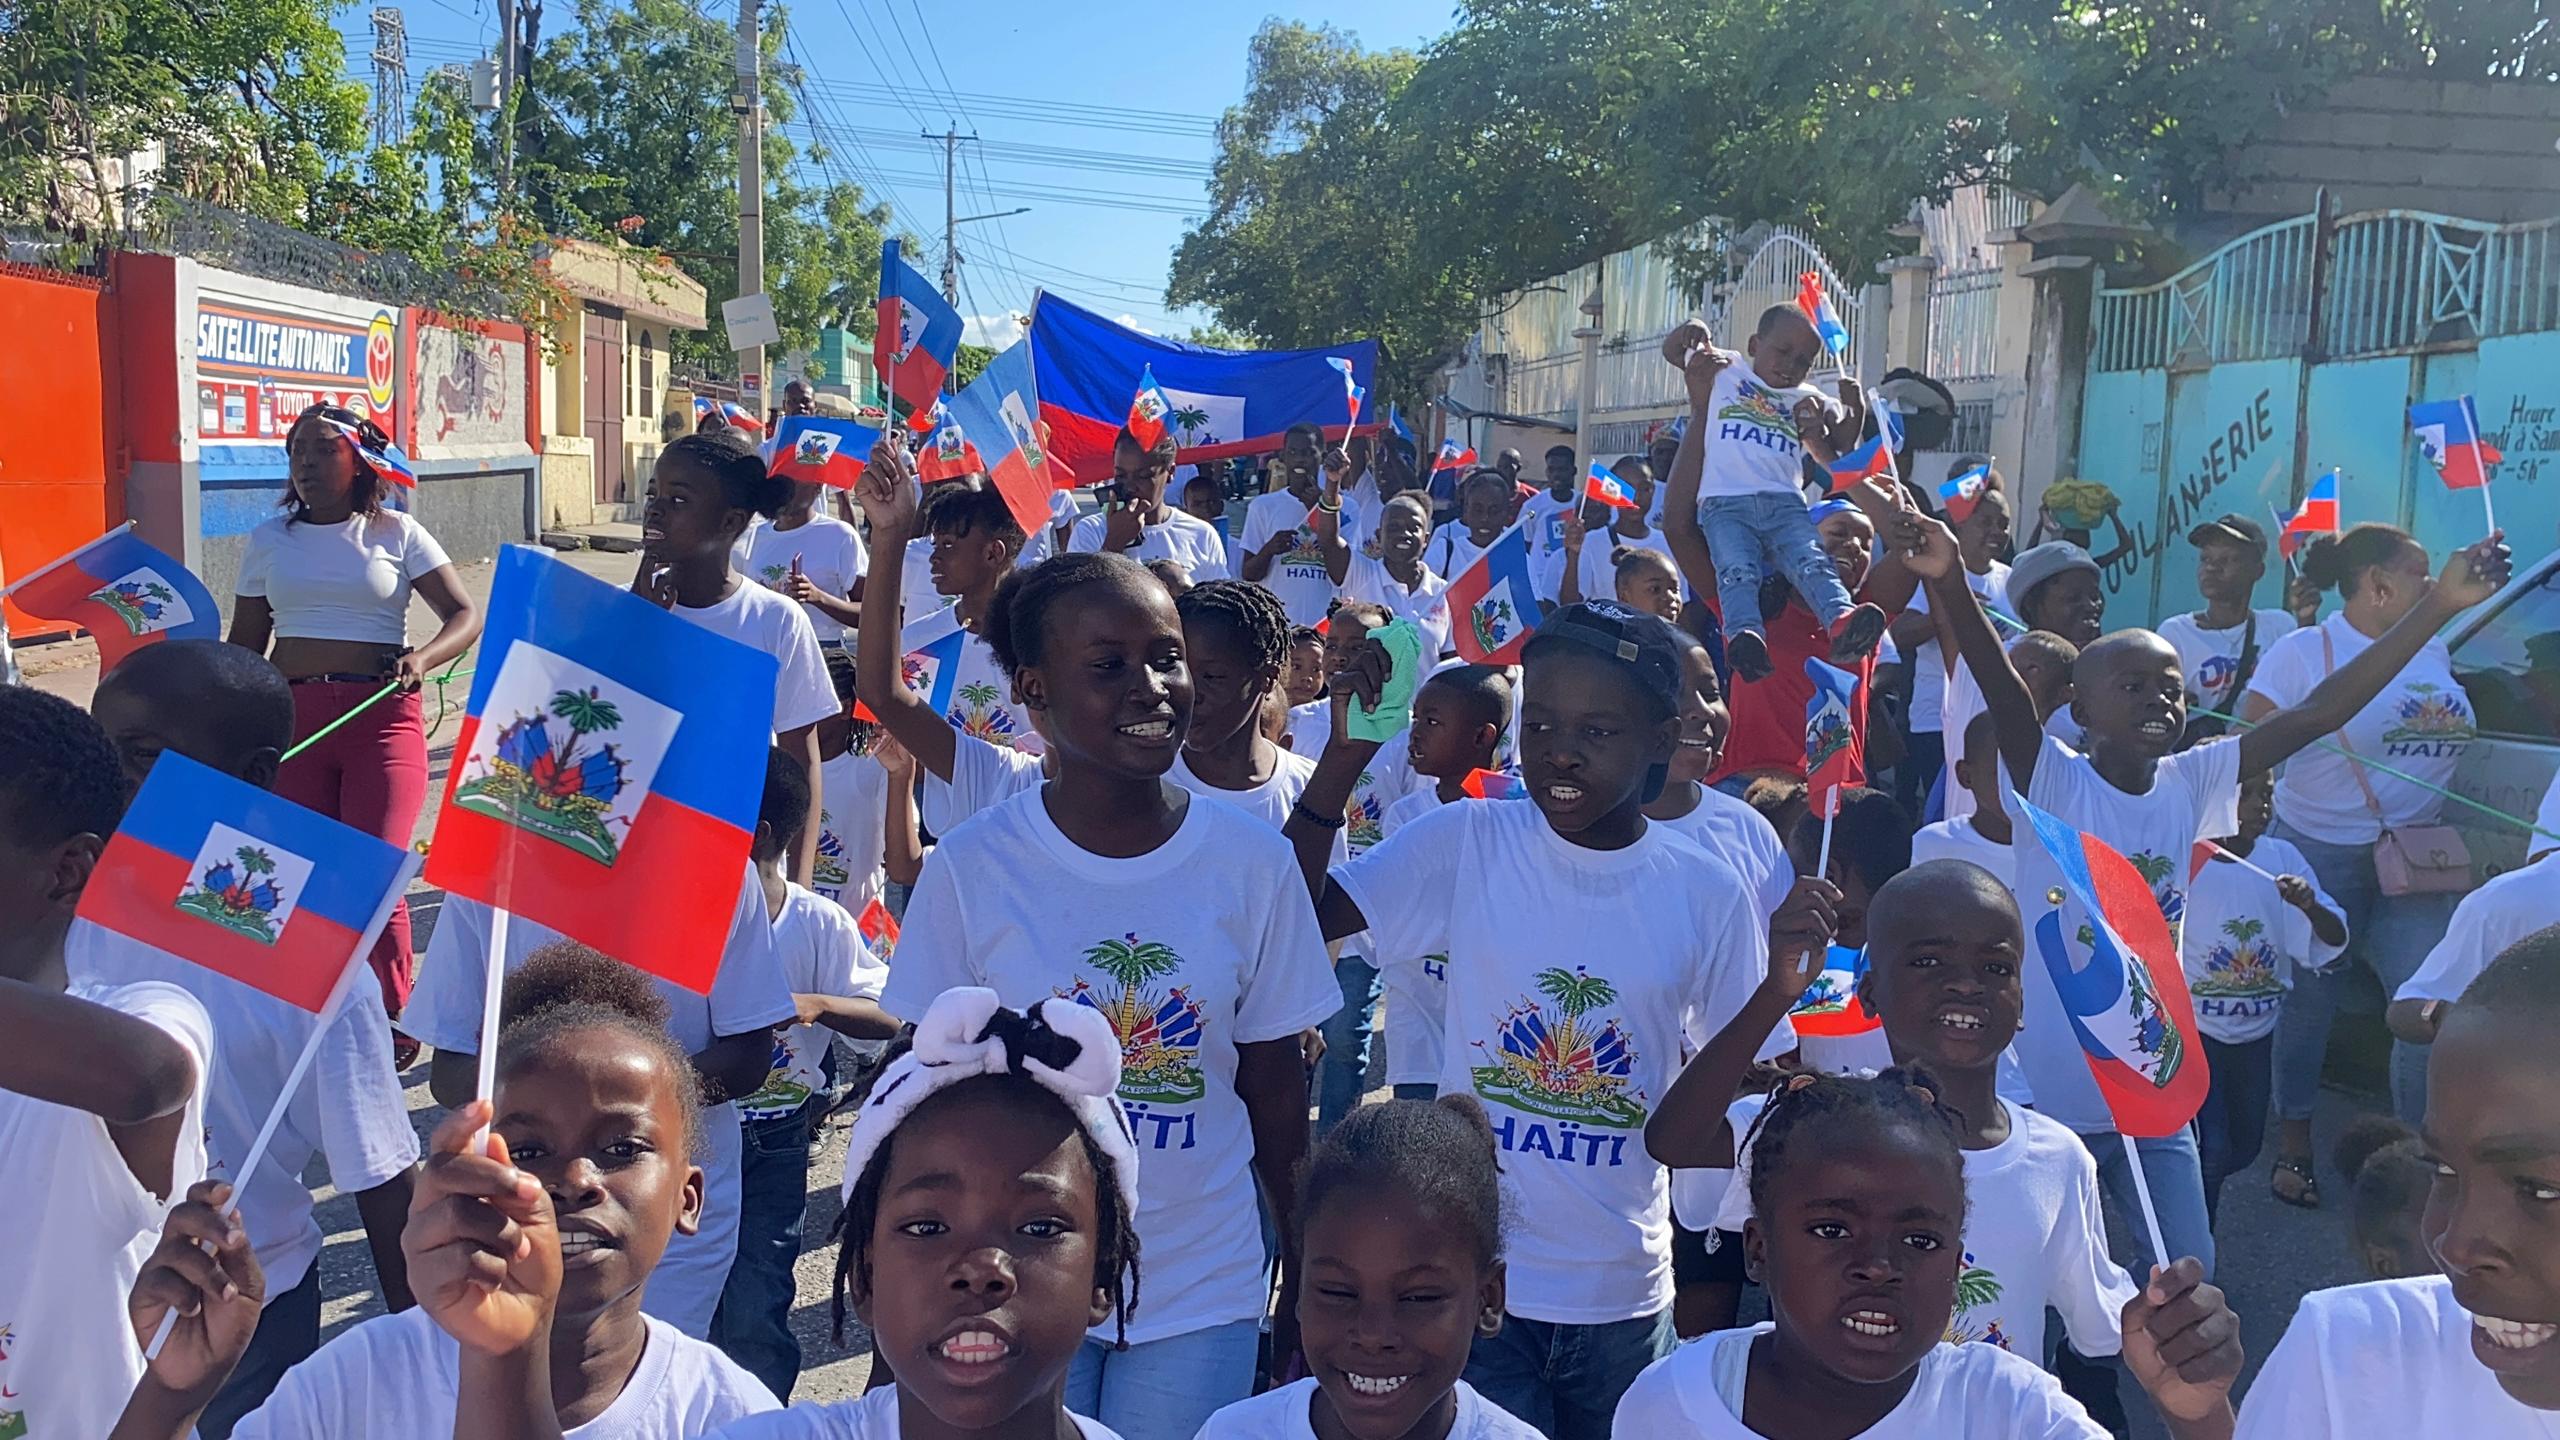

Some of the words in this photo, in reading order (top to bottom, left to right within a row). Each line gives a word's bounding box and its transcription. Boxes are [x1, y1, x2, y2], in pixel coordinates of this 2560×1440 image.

[197, 313, 279, 367] SATELLITE
[278, 326, 313, 371] AUTO
[312, 331, 351, 375] PARTS
[1720, 423, 1798, 459] HAÏTI
[2105, 387, 2273, 595] OULANGERIE
[2387, 739, 2469, 758] HAÏTI
[1123, 1102, 1195, 1149] ÏTI
